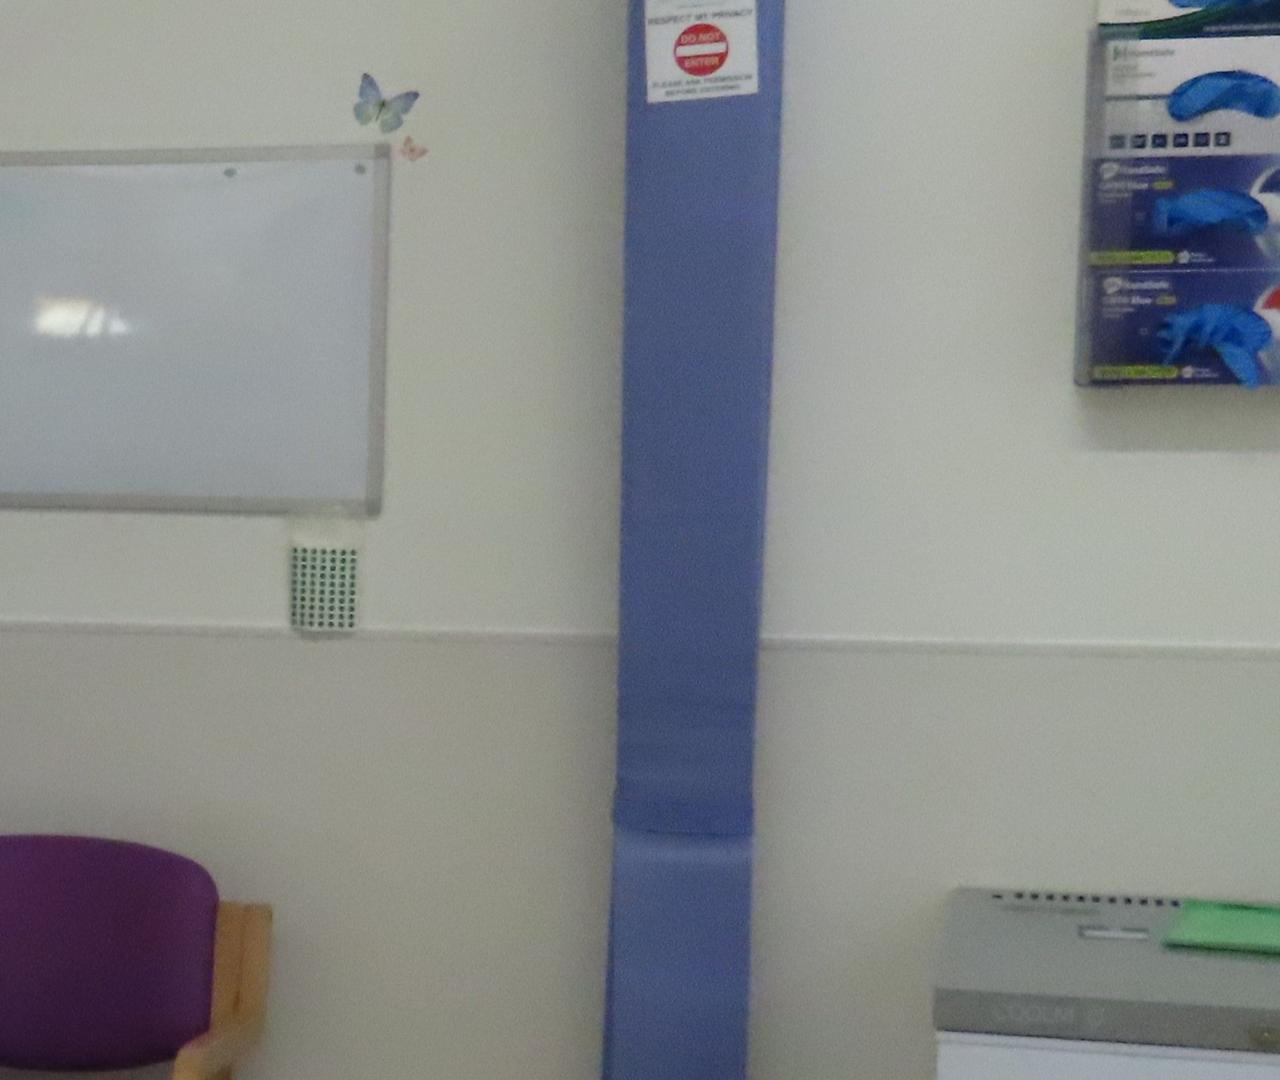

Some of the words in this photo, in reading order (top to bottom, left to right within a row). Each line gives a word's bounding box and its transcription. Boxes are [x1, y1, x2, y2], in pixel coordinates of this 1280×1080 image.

[711, 9, 753, 18] PRIVACY
[680, 33, 697, 43] DO
[698, 31, 721, 41] NOT
[684, 57, 720, 68] ENTER
